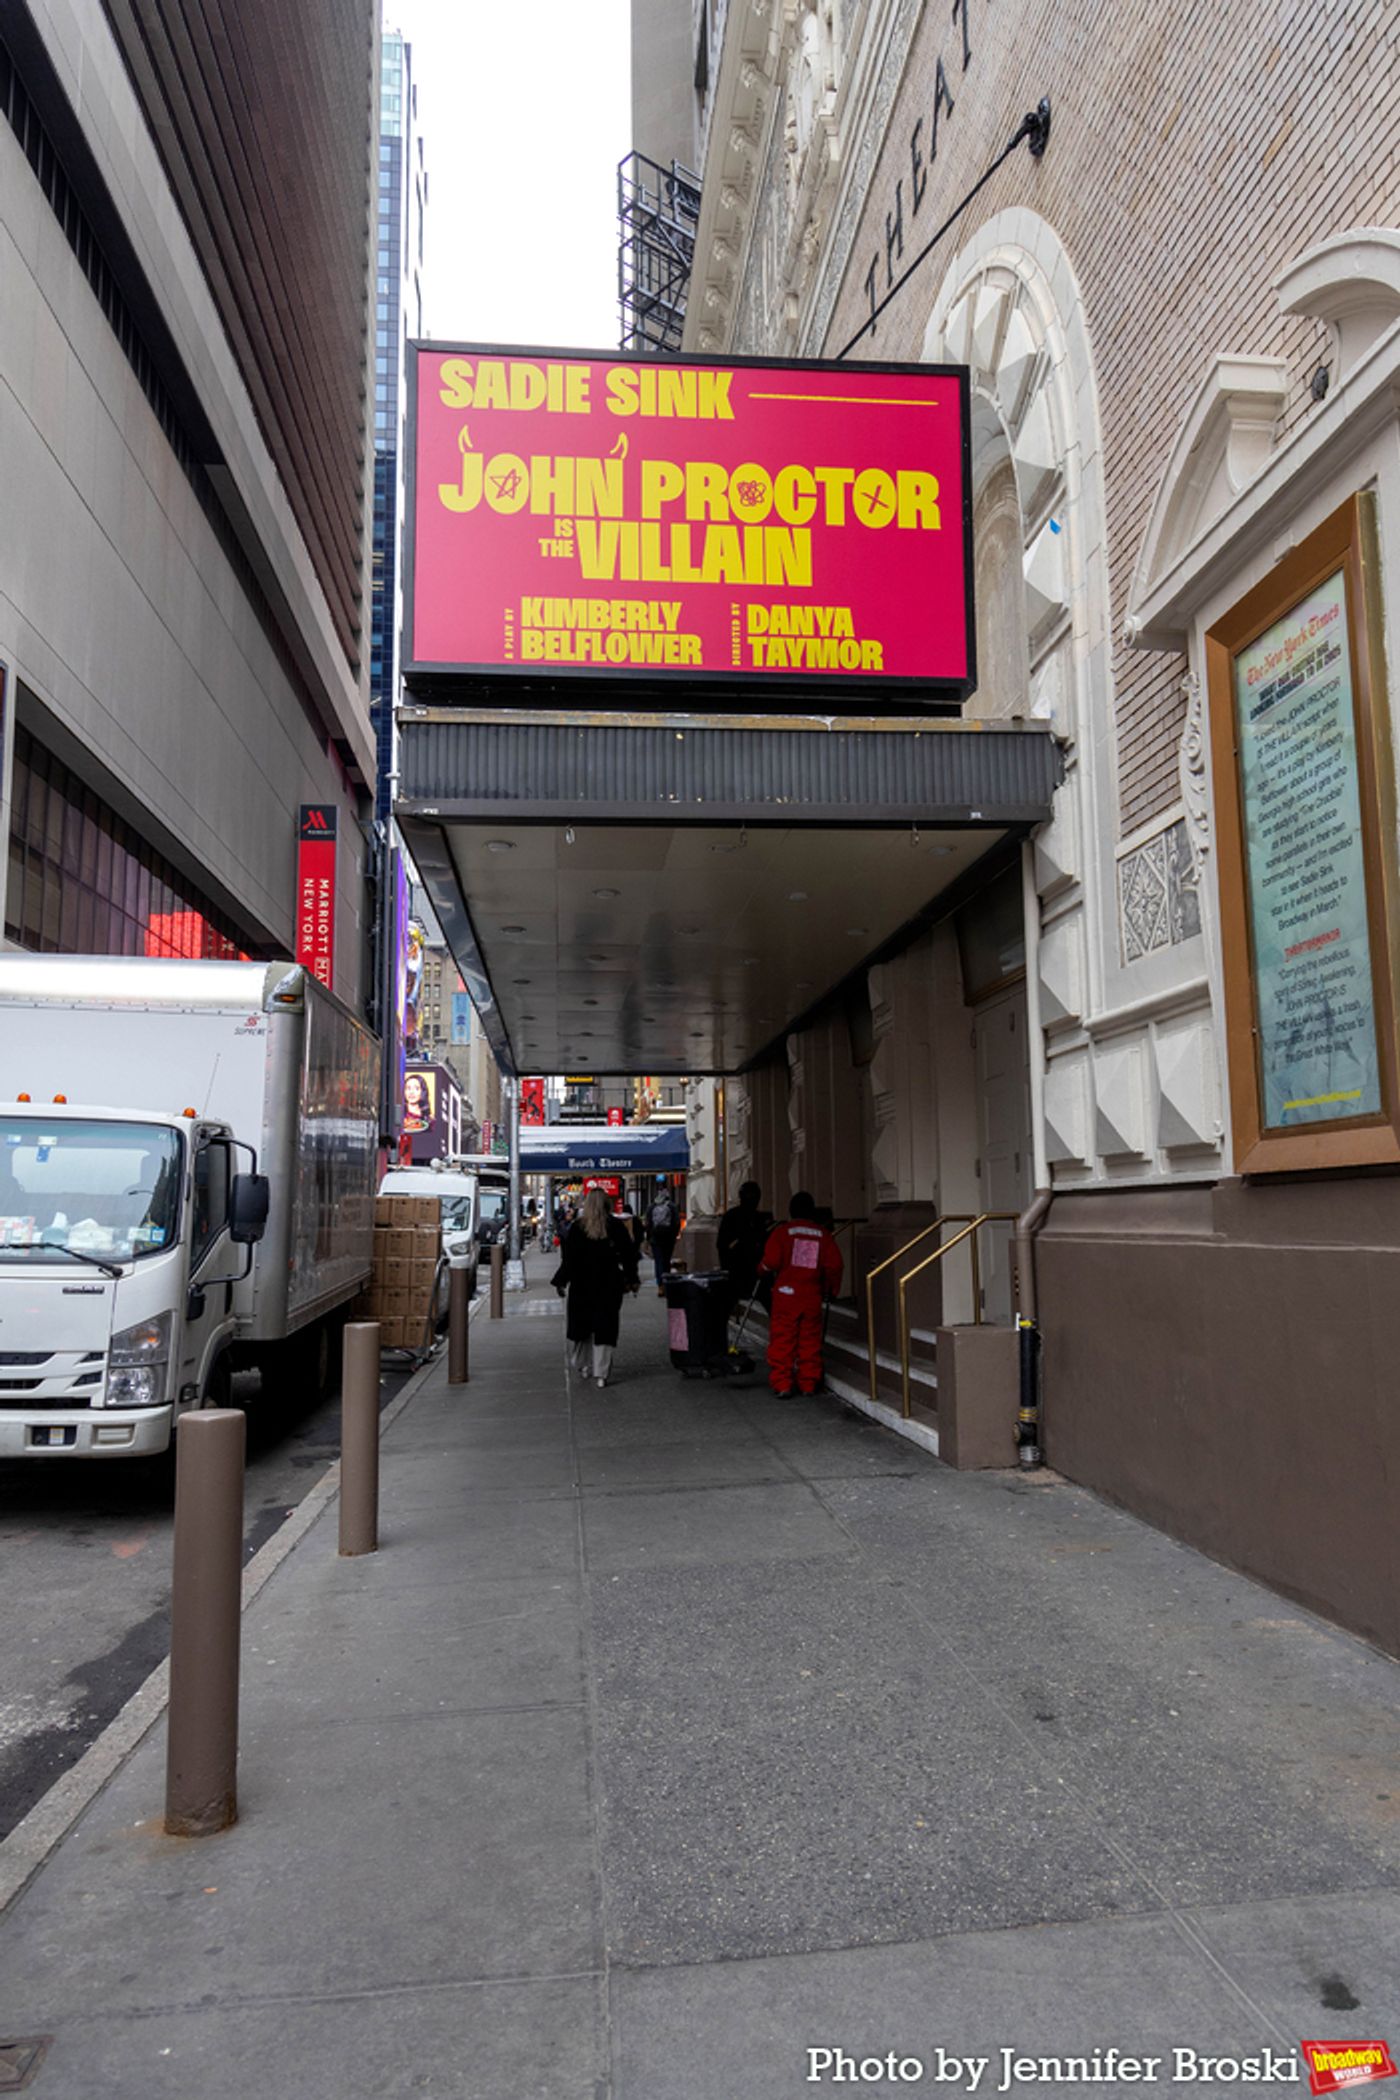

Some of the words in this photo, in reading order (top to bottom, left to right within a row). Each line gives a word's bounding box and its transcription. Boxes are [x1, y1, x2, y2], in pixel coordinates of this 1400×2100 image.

[439, 359, 591, 413] SADIE
[606, 367, 735, 419] SINK
[438, 450, 625, 517] JOHN
[641, 460, 942, 530] PROCTOR
[554, 518, 574, 537] IS
[538, 538, 574, 558] THE
[575, 519, 813, 587] VILLAIN
[504, 608, 514, 621] BY
[521, 597, 682, 631] KIMBERLY
[731, 602, 741, 616] BY
[747, 604, 854, 638] DANYA
[504, 624, 514, 649] PLAY
[521, 629, 703, 665] BELFLOWER
[732, 618, 741, 666] DIRECTED
[748, 635, 884, 670] TAYMOR
[504, 652, 513, 660] A
[303, 878, 315, 909] NEW
[318, 879, 330, 953] MARRIOTT
[302, 916, 313, 953] YORK
